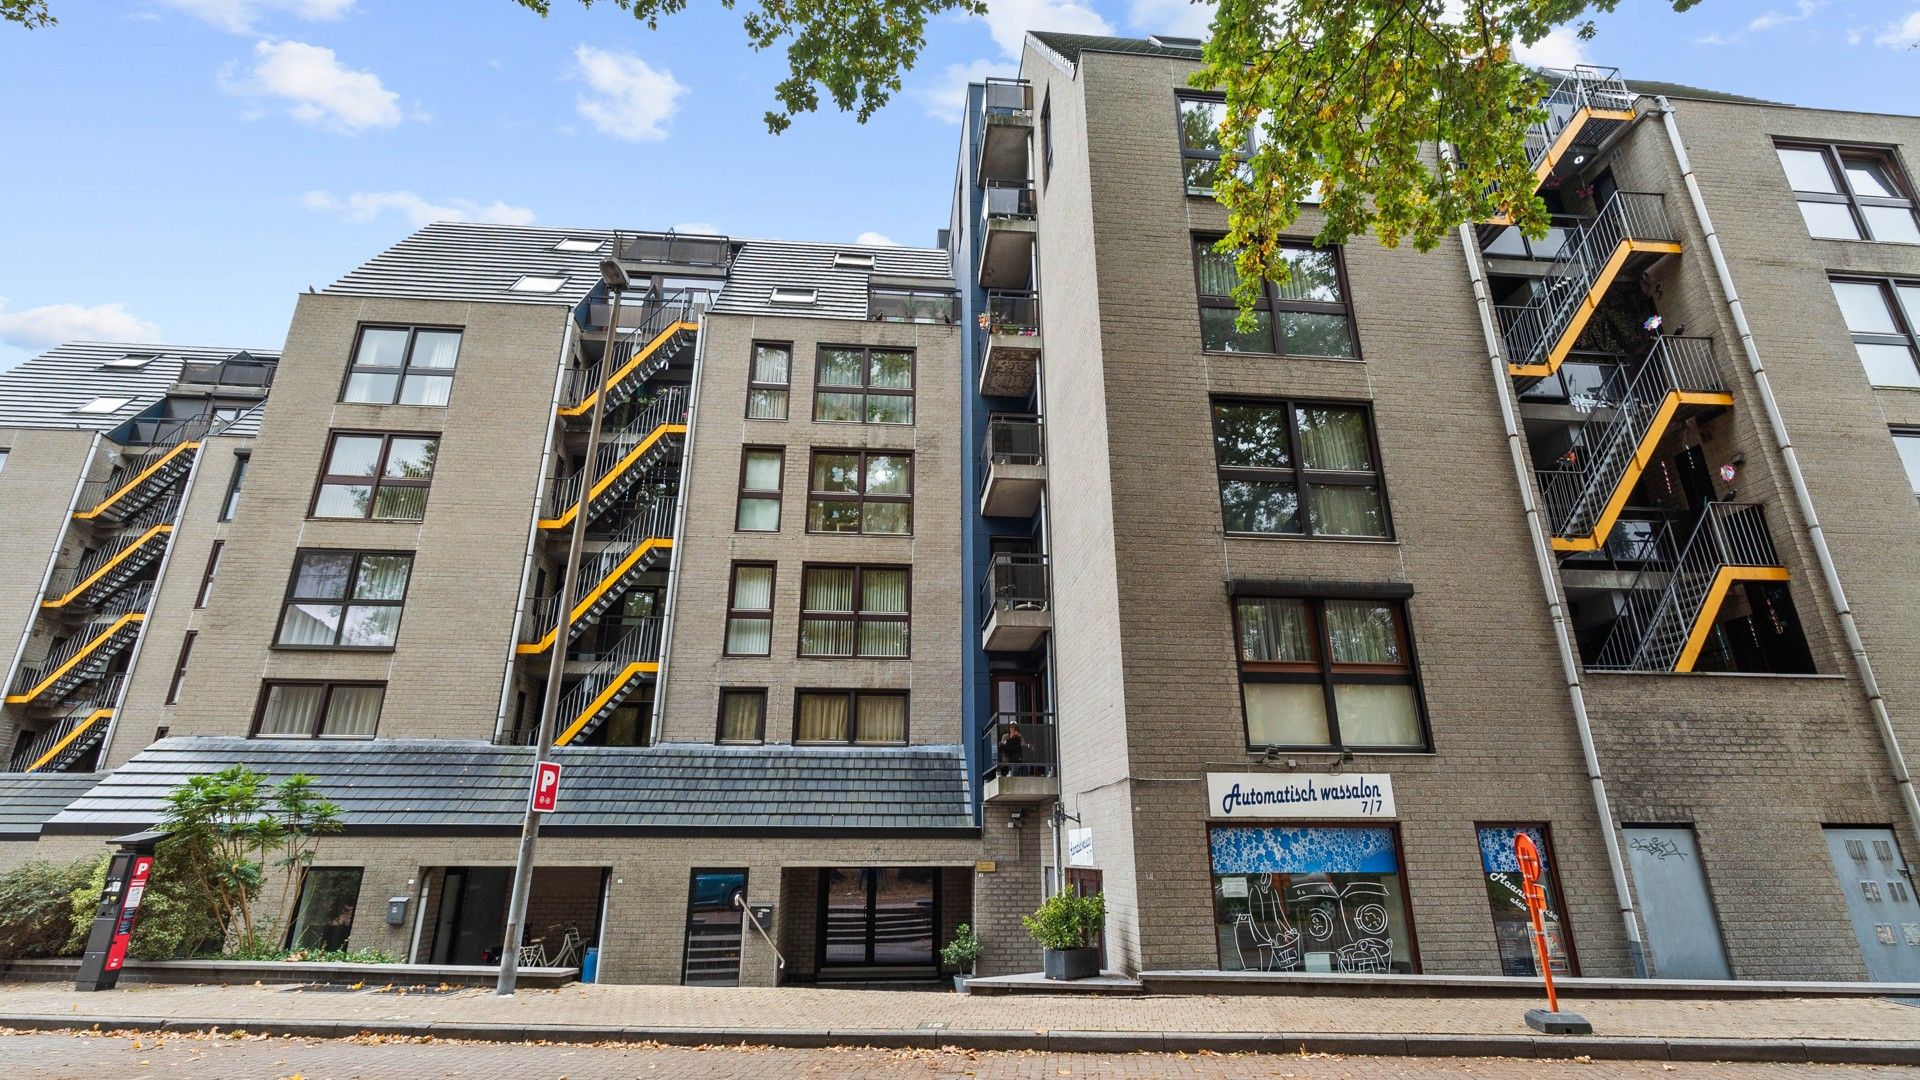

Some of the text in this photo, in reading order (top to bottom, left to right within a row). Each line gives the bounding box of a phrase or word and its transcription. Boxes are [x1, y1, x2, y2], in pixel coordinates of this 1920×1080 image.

[540, 770, 556, 792] P
[1222, 776, 1382, 814] Automatisch wassalon
[1361, 799, 1383, 816] 7/7
[136, 862, 149, 876] P
